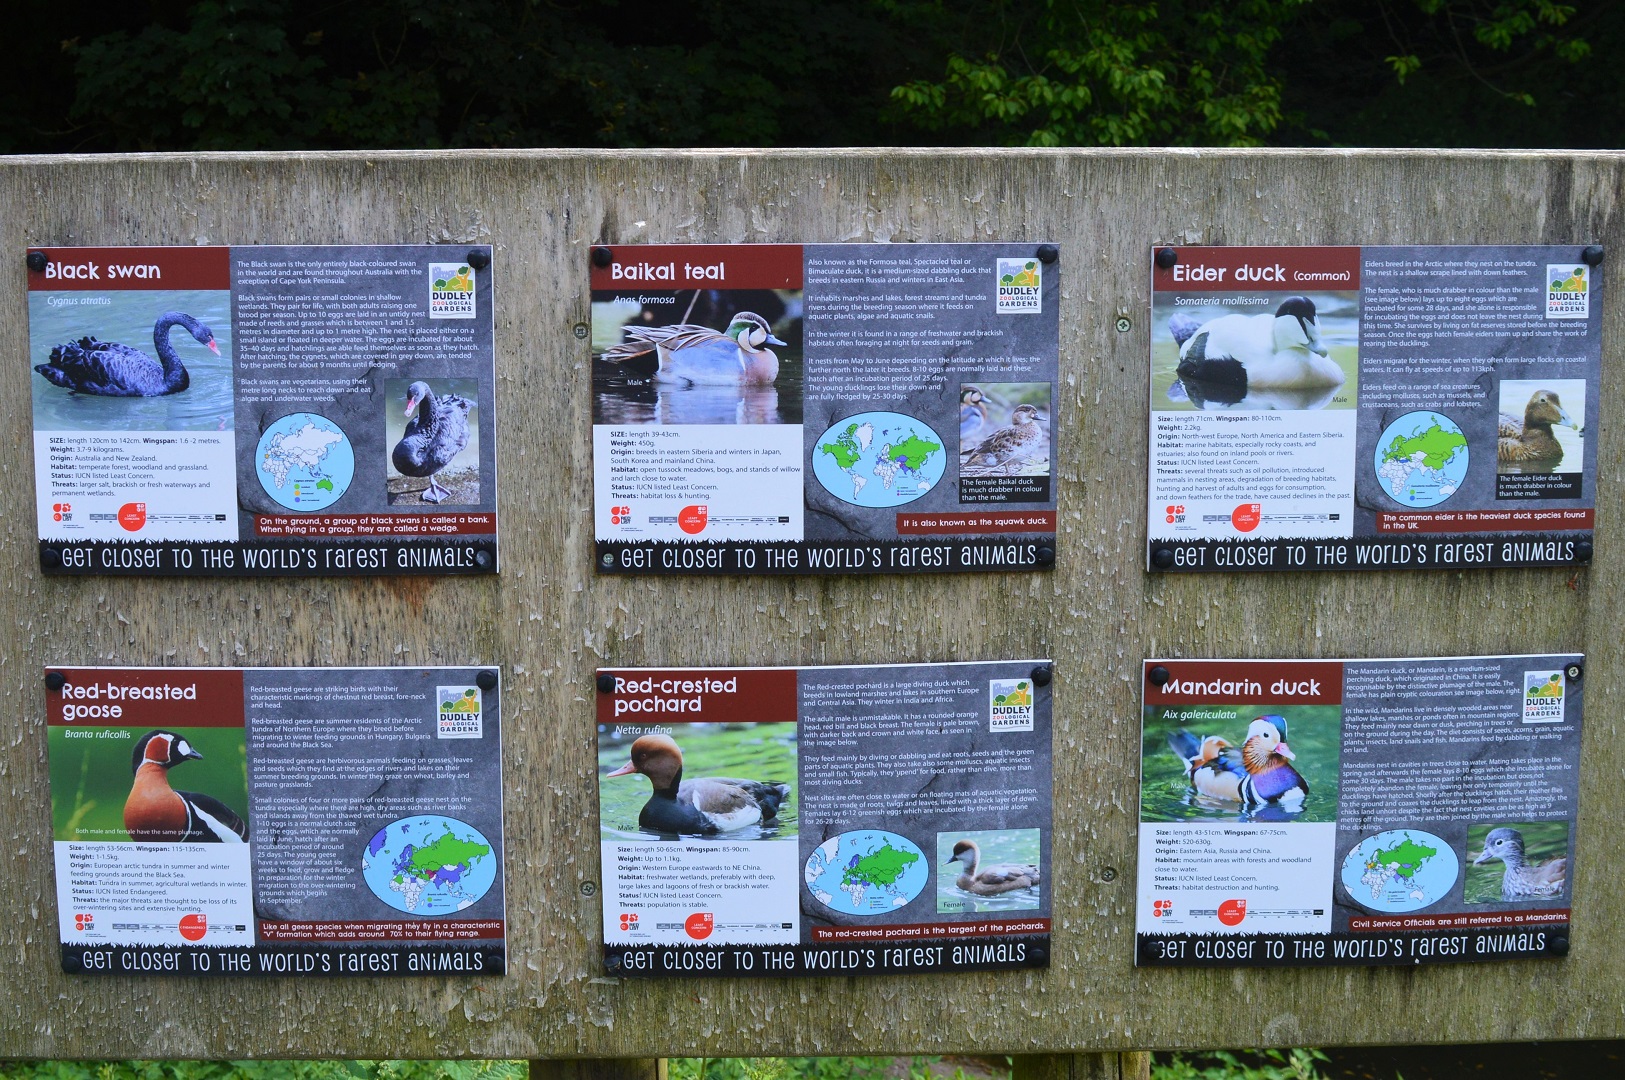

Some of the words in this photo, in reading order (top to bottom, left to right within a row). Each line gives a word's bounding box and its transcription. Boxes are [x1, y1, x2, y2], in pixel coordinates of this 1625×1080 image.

[46, 262, 100, 279] Black
[108, 265, 161, 278] swan
[612, 263, 675, 280] Baikal
[685, 262, 724, 280] teal
[1174, 264, 1226, 281] Eider
[1235, 264, 1286, 281] duck
[1294, 271, 1350, 281] (common)
[433, 291, 473, 300] DUDLEY
[1000, 287, 1039, 295] DUDLEY
[1550, 292, 1586, 300] DUDLEY
[48, 296, 78, 307] Cygnus
[639, 295, 675, 304] formosa
[1175, 297, 1220, 305] Somateria
[1223, 296, 1269, 305] mollissima
[275, 518, 288, 526] the
[291, 518, 321, 526] ground,
[432, 517, 456, 525] called
[995, 518, 1024, 526] squawk
[328, 525, 354, 534] group,
[615, 677, 736, 694] Red-crested
[1162, 679, 1261, 695] Mandarin
[1271, 679, 1320, 696] duck
[63, 683, 196, 700] Red-breasted
[615, 696, 701, 716] pochard
[1527, 698, 1562, 706] DUDLEY
[63, 705, 122, 720] goose
[993, 706, 1031, 714] DUDLEY
[1163, 710, 1178, 718] Aix
[1181, 710, 1236, 721] galericulata
[65, 730, 93, 738] Branta
[96, 730, 130, 738] ruficollis
[615, 726, 641, 735] Netta
[644, 725, 672, 735] rufina
[886, 928, 920, 937] pochard
[949, 926, 976, 934] largest
